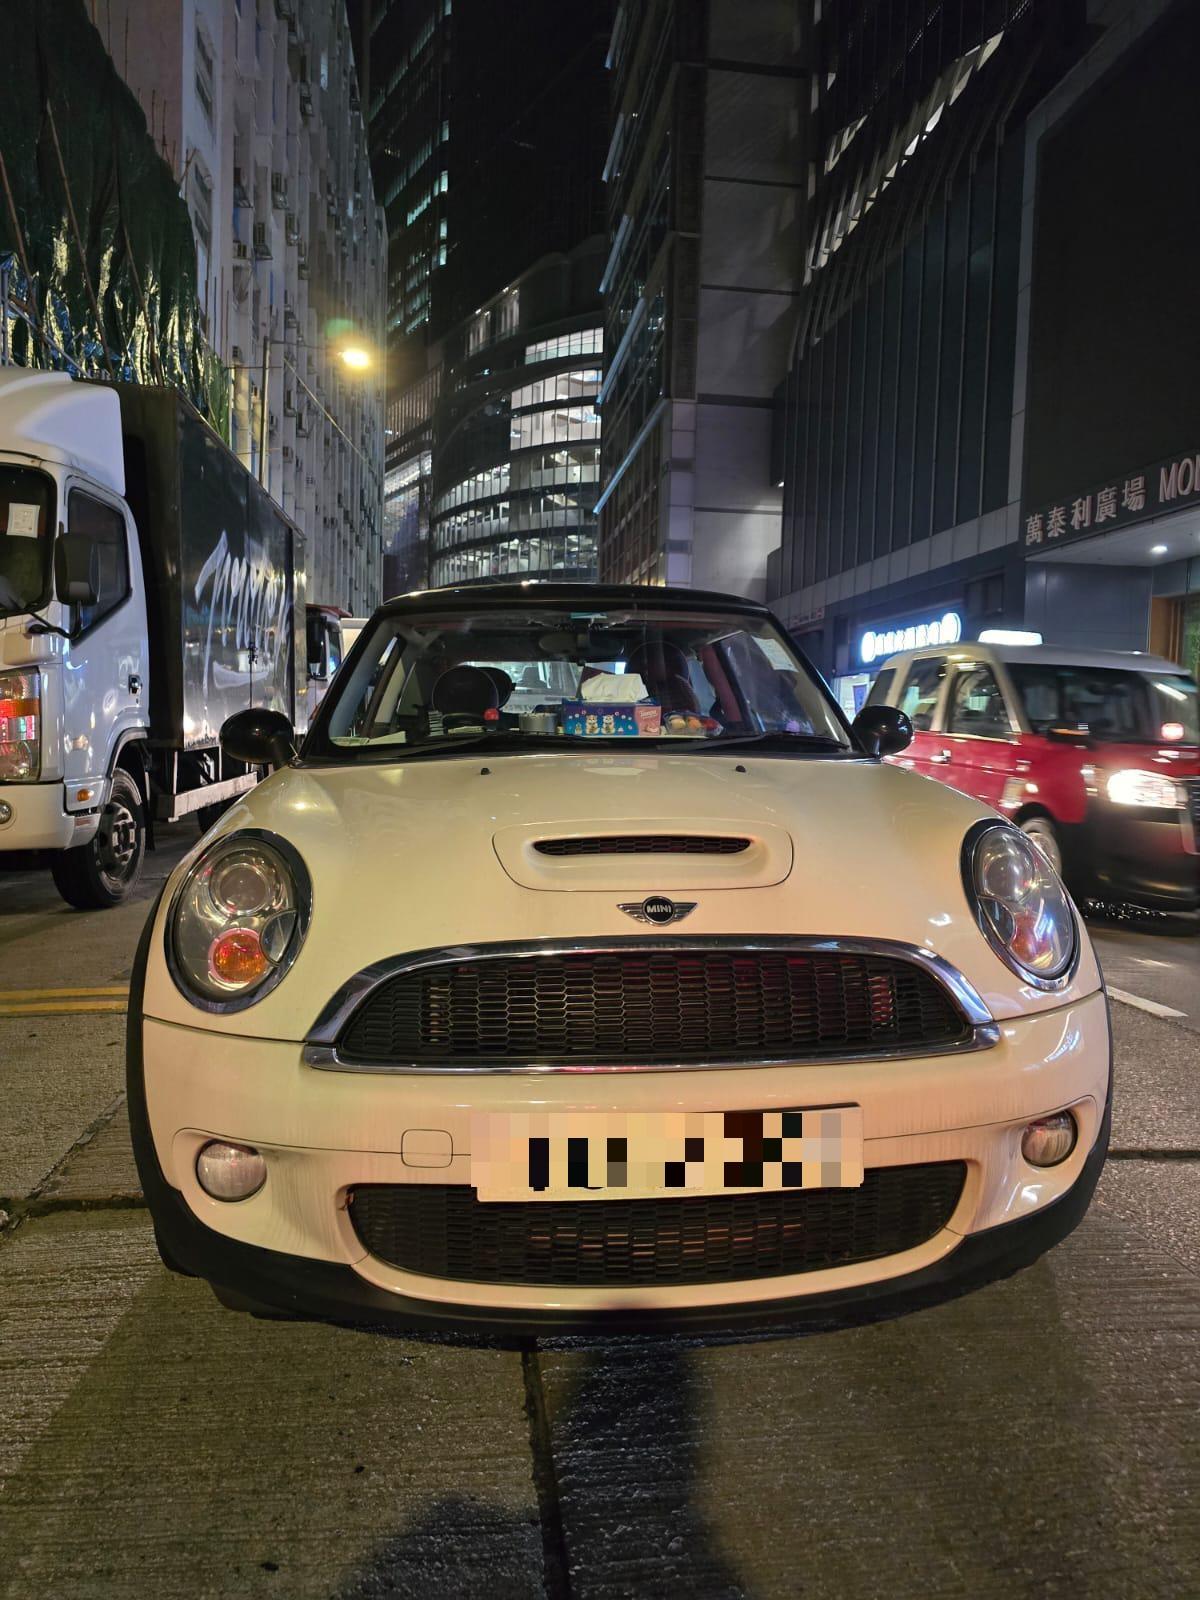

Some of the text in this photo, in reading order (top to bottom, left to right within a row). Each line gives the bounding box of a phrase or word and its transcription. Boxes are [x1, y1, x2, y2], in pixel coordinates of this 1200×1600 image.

[1025, 476, 1147, 546] 萬泰利廣場
[646, 904, 672, 913] MINI
